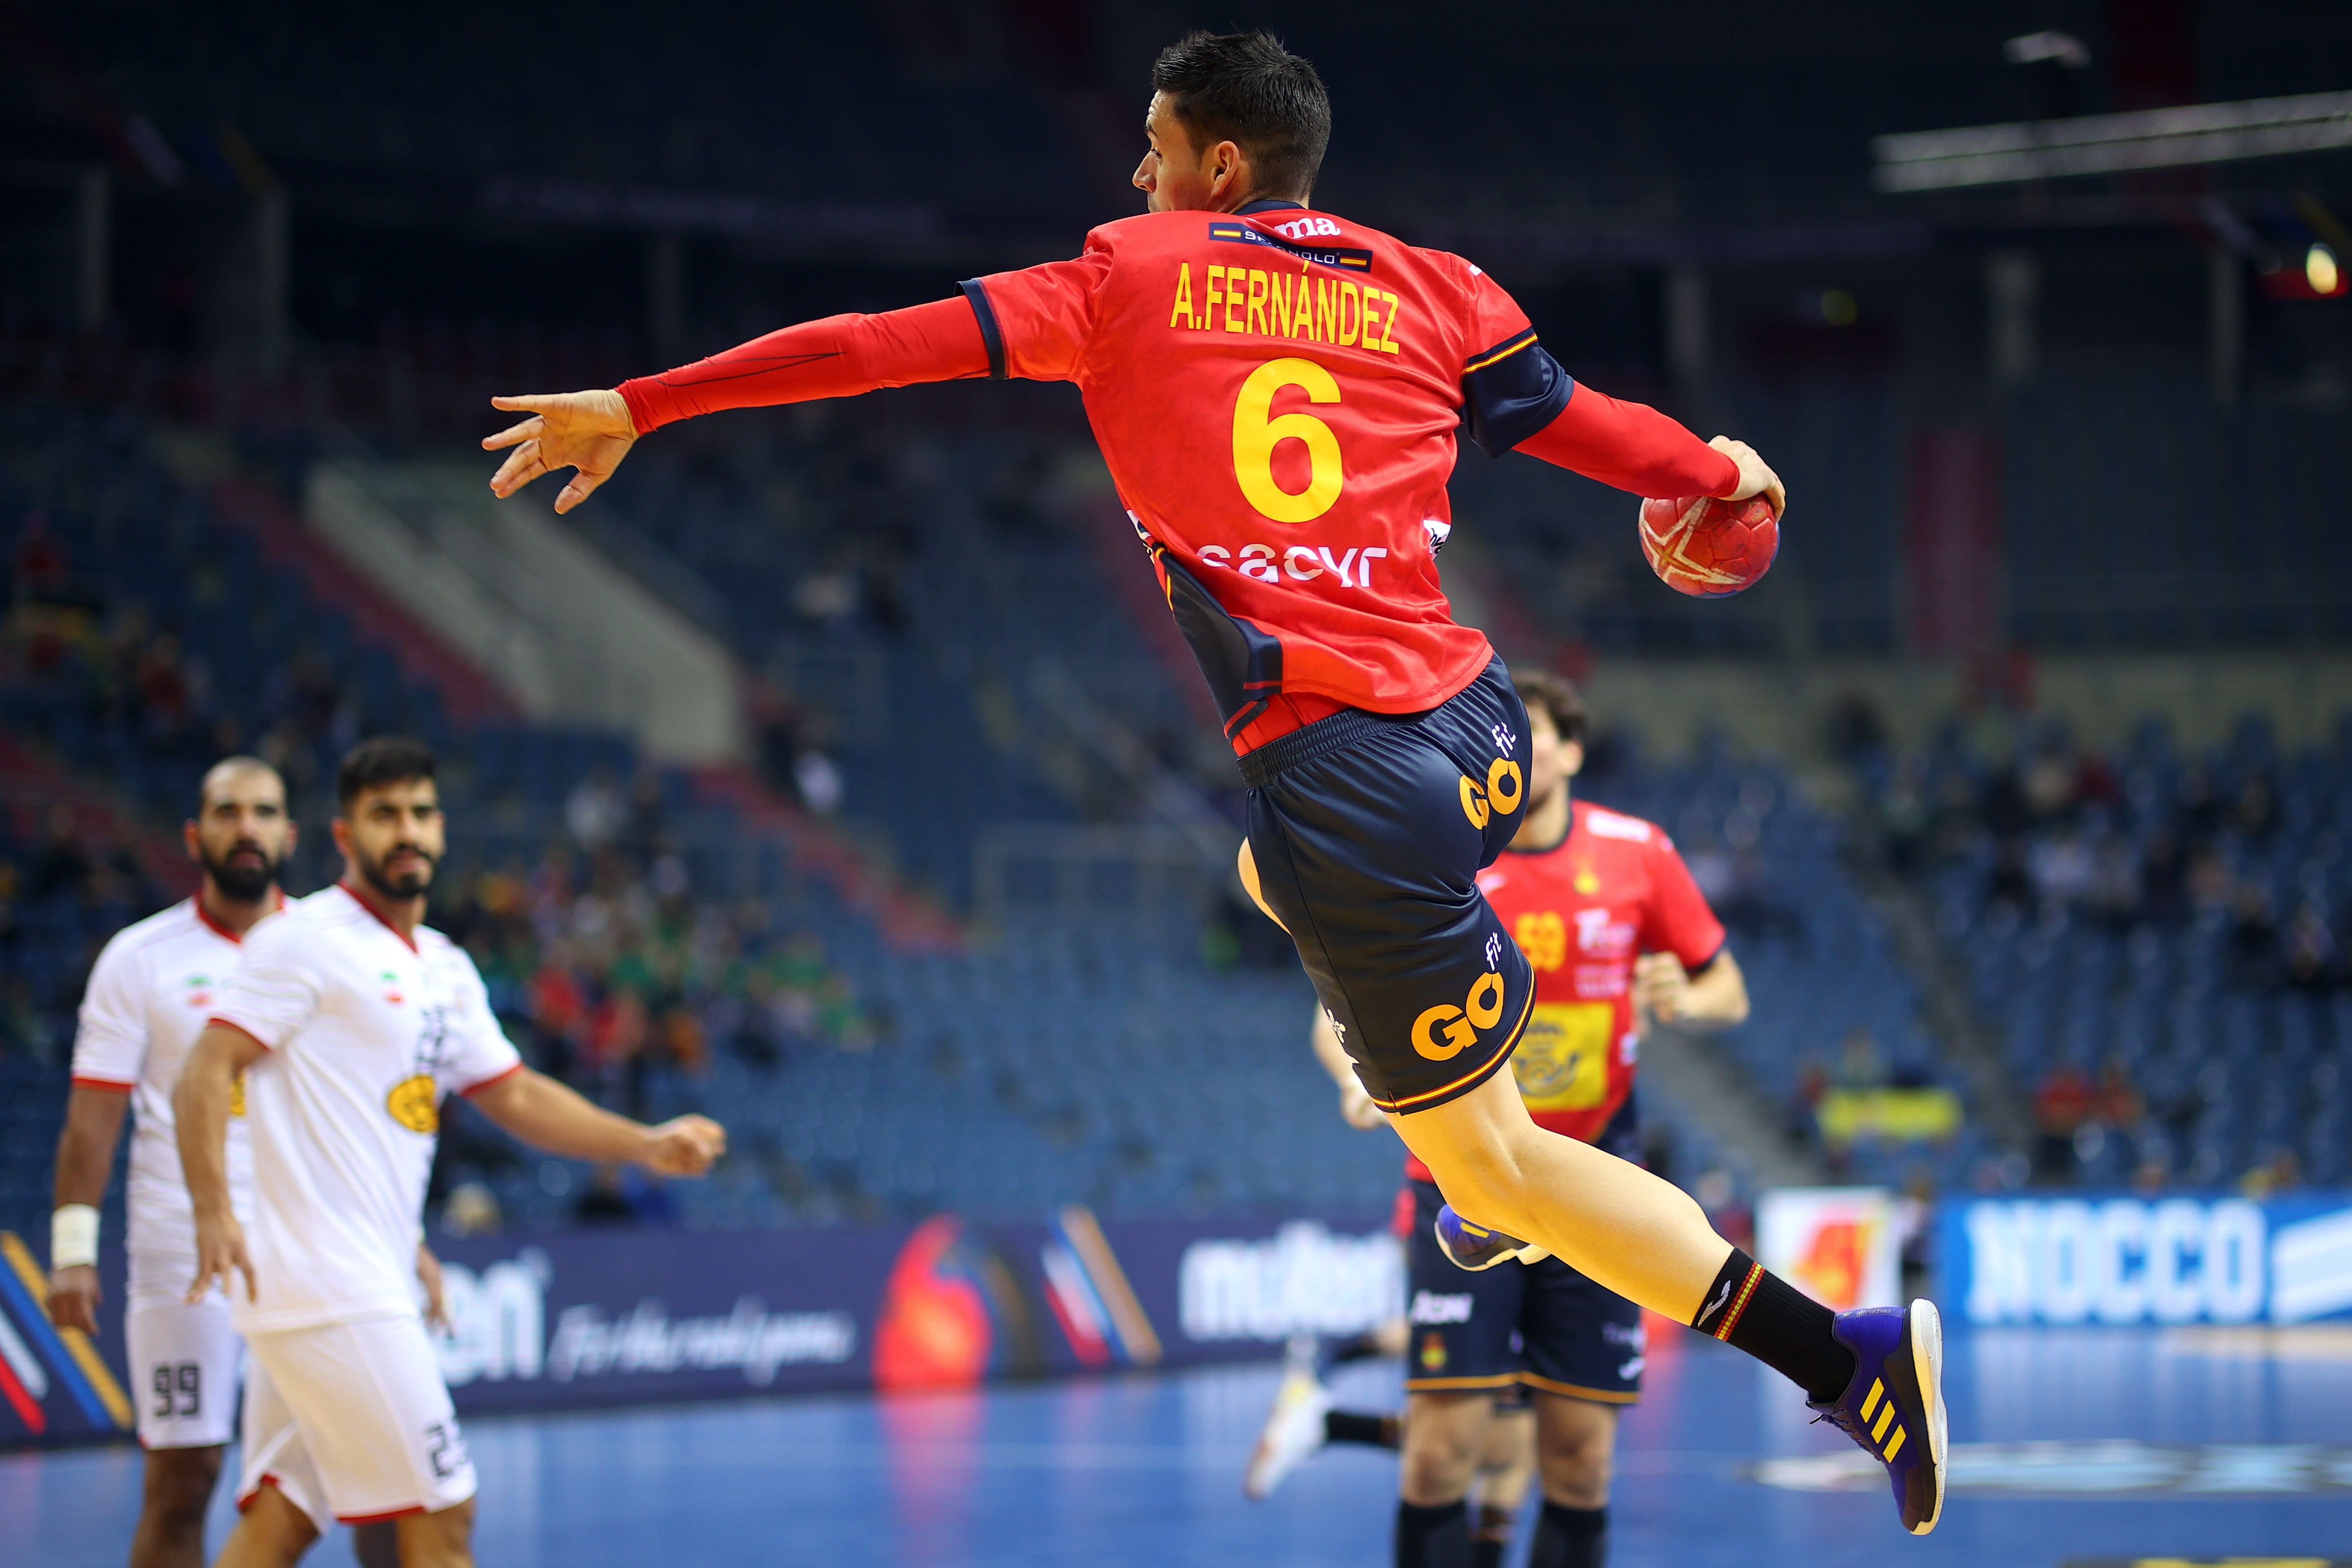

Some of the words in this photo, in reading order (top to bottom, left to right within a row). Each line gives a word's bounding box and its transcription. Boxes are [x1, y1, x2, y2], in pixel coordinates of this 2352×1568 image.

[1169, 260, 1400, 355] A.FERNÁNDEZ
[1232, 357, 1344, 524] 6
[1196, 543, 1388, 588] sacyr
[1459, 756, 1523, 831] GO
[1411, 971, 1505, 1062] GO
[1485, 931, 1503, 971] fit
[1963, 1199, 2265, 1324] NOCCO
[152, 1363, 200, 1416] 99
